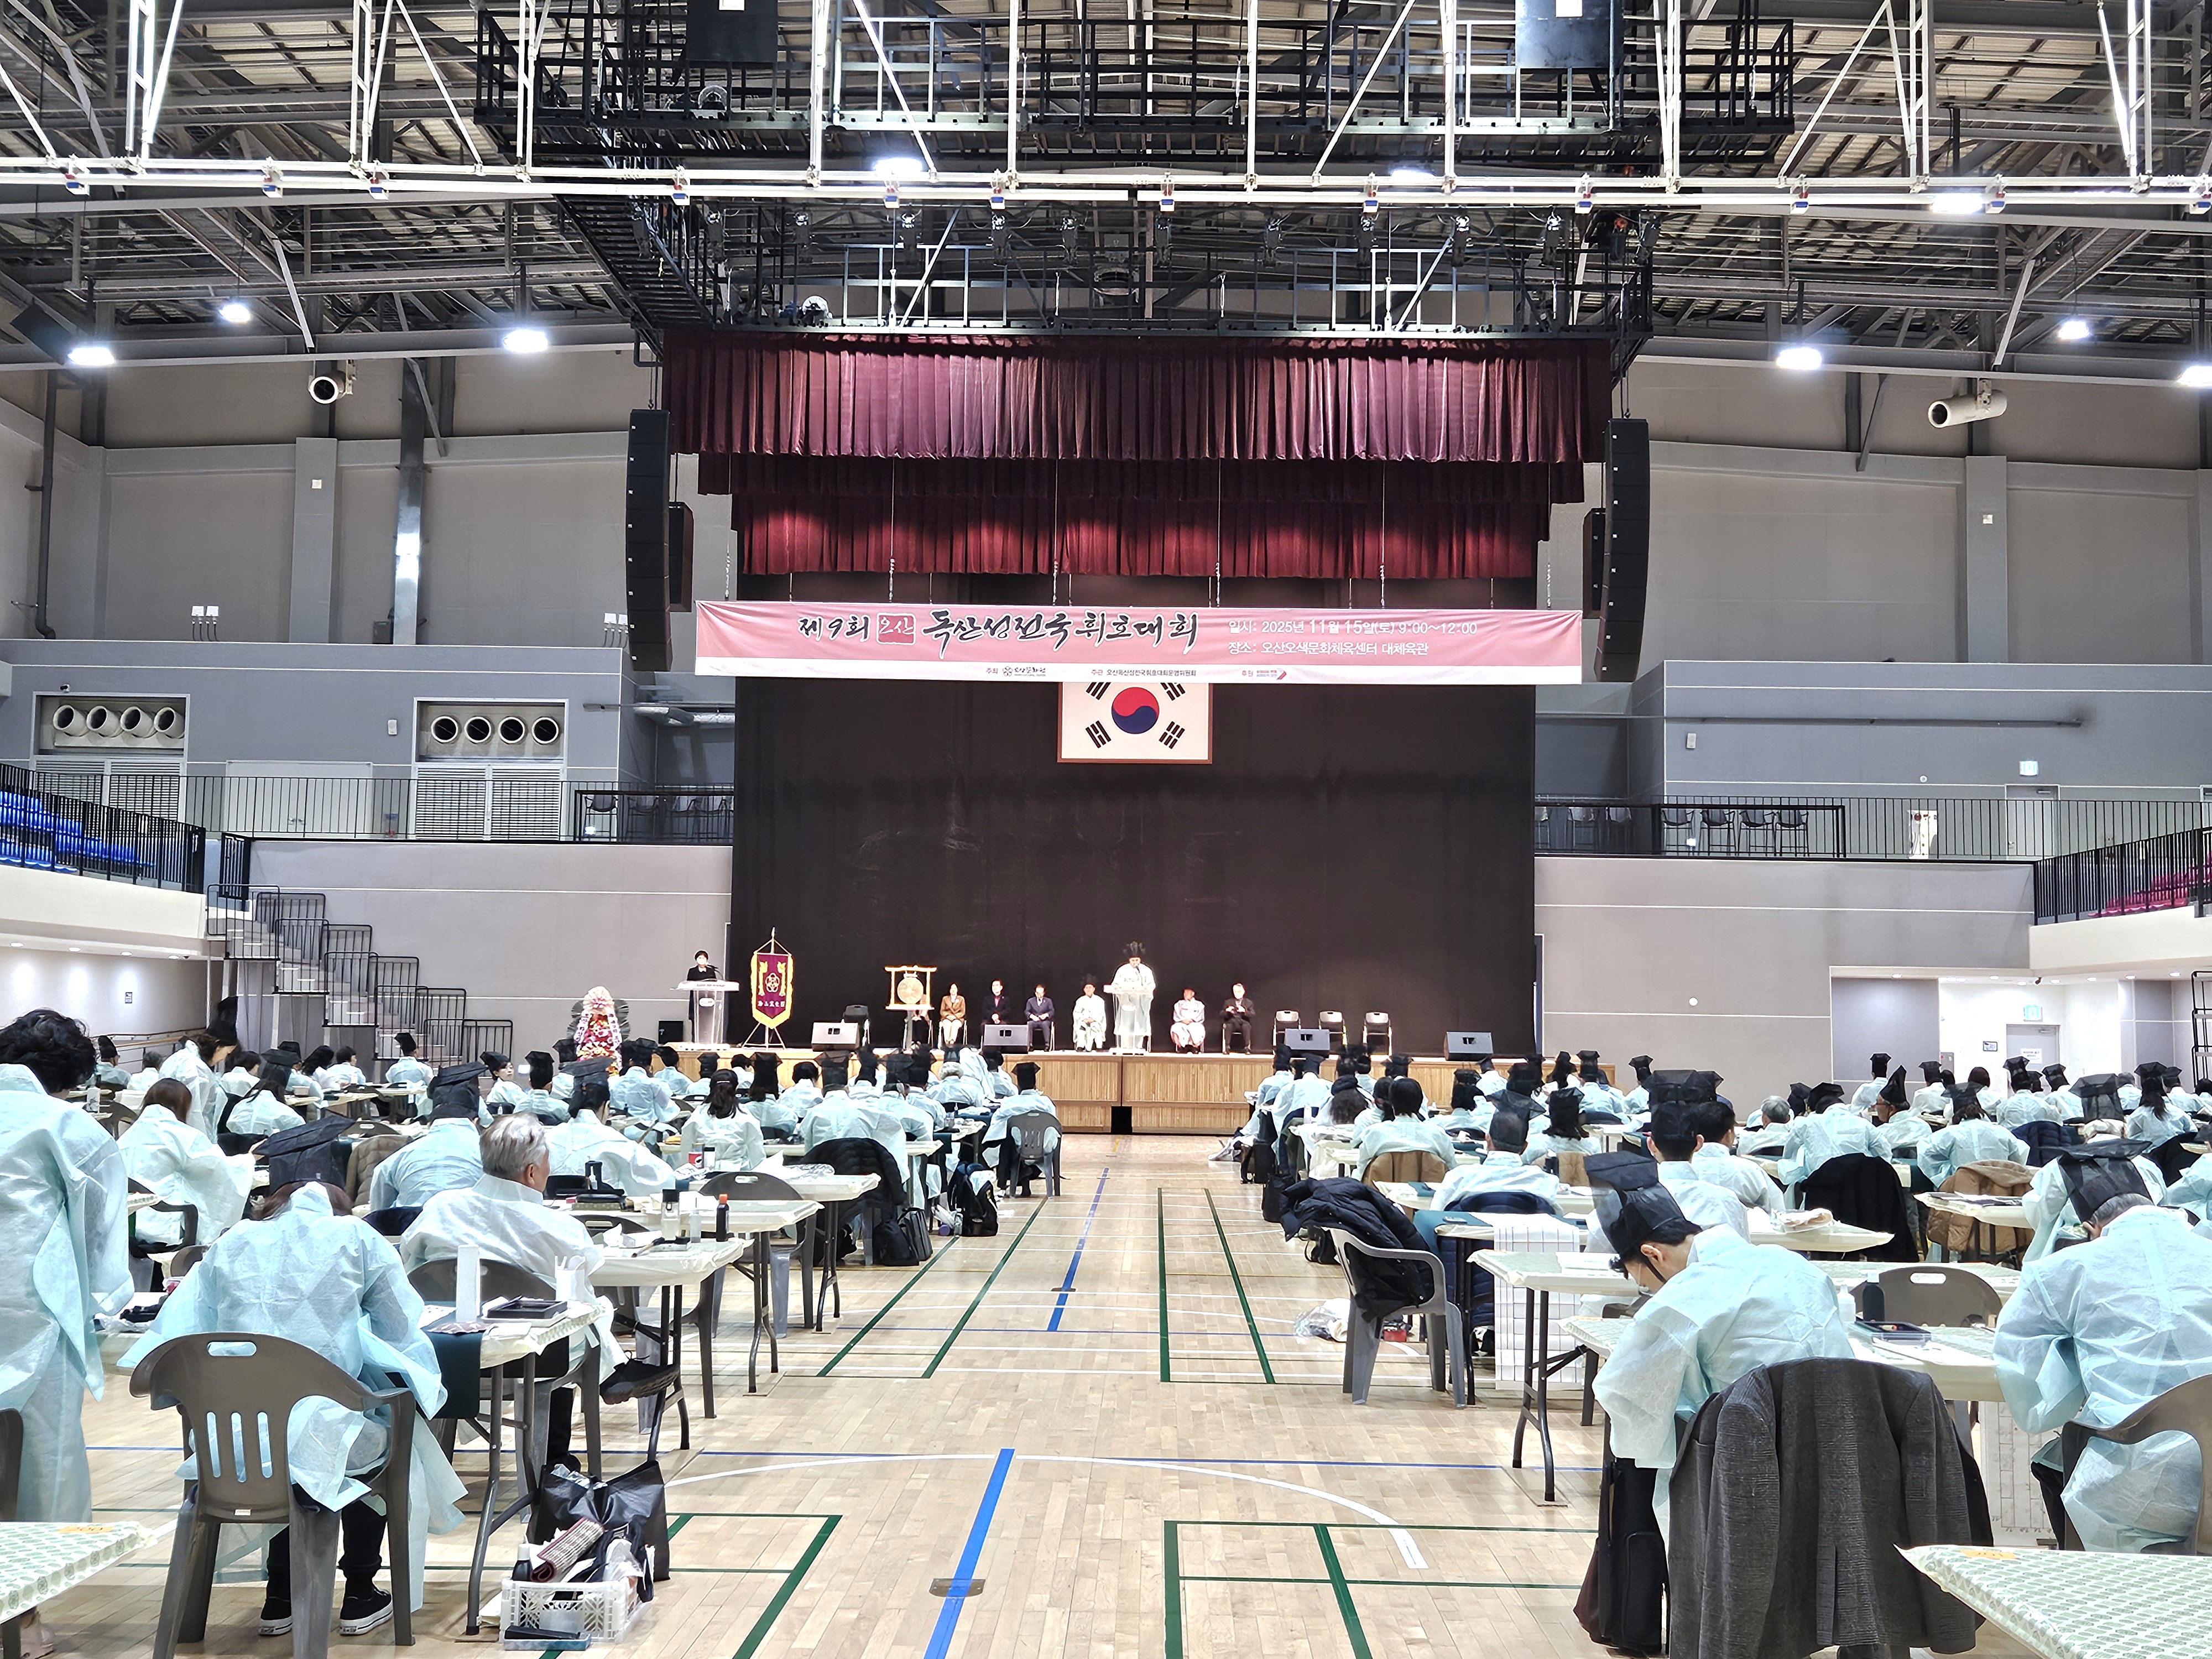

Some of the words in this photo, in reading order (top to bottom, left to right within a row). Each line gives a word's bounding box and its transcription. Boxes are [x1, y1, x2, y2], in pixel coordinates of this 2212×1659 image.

[799, 614, 870, 641] 제9회
[879, 616, 914, 635] 오산
[1229, 620, 1258, 633] 일시:
[1261, 621, 1304, 633] 2025년
[1310, 619, 1340, 634] 11월
[1344, 620, 1394, 634] 15일(토)
[1398, 622, 1478, 634] 9:00~12:00
[1228, 641, 1257, 654] 장소:
[1261, 641, 1377, 655] 오산오색문화체육센터
[1382, 642, 1428, 655] 대체육관
